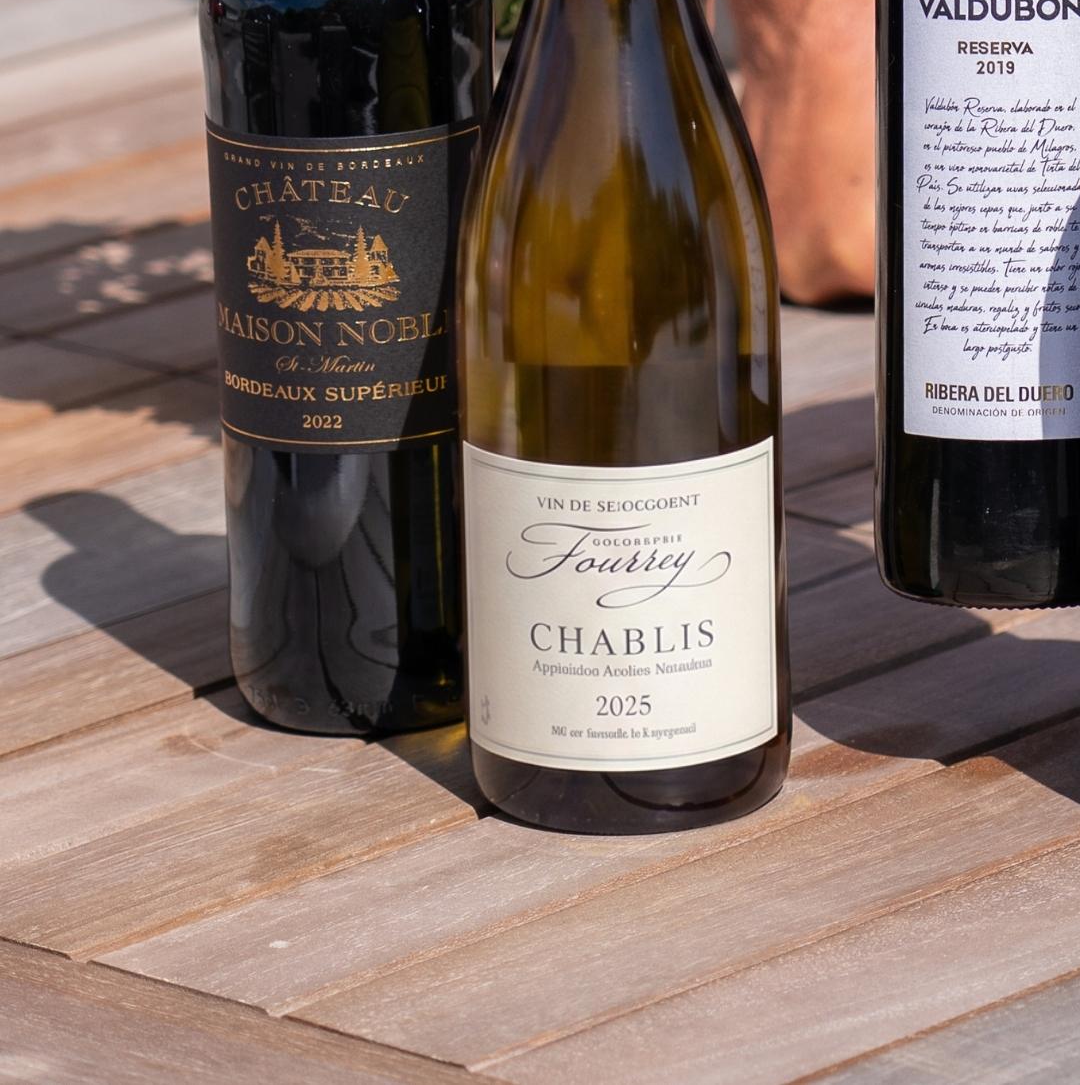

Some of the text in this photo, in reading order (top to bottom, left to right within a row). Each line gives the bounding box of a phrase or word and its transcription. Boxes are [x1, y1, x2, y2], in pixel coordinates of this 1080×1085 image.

[957, 41, 1034, 55] RESERVA
[976, 61, 1015, 75] 2019
[1010, 98, 1051, 113] elaborado
[980, 117, 1018, 138] Ribera
[1021, 118, 1036, 133] del
[984, 139, 1014, 157] pueblo
[223, 152, 424, 171] GRAND VIN DE BORDEAUX
[949, 163, 965, 172] vino
[1040, 157, 1065, 176] Tinta
[234, 175, 411, 213] CHÂTEAU
[1007, 185, 1028, 194] uvas
[934, 197, 945, 211] las
[1039, 240, 1070, 254] sabores
[1003, 257, 1027, 277] Tiene
[1046, 259, 1065, 272] color
[217, 302, 323, 346] MAISON
[963, 339, 985, 360] largo
[224, 370, 316, 402] BORDEAUX
[925, 382, 1074, 402] RIBERA DEL DUERO
[932, 406, 1007, 417] DENOMINACIÓN
[1011, 409, 1023, 417] DE
[302, 414, 343, 430] 2022
[537, 496, 564, 510] VIN
[570, 500, 591, 512] DE
[530, 619, 715, 656] CHABLIS
[595, 695, 652, 717] 2025
